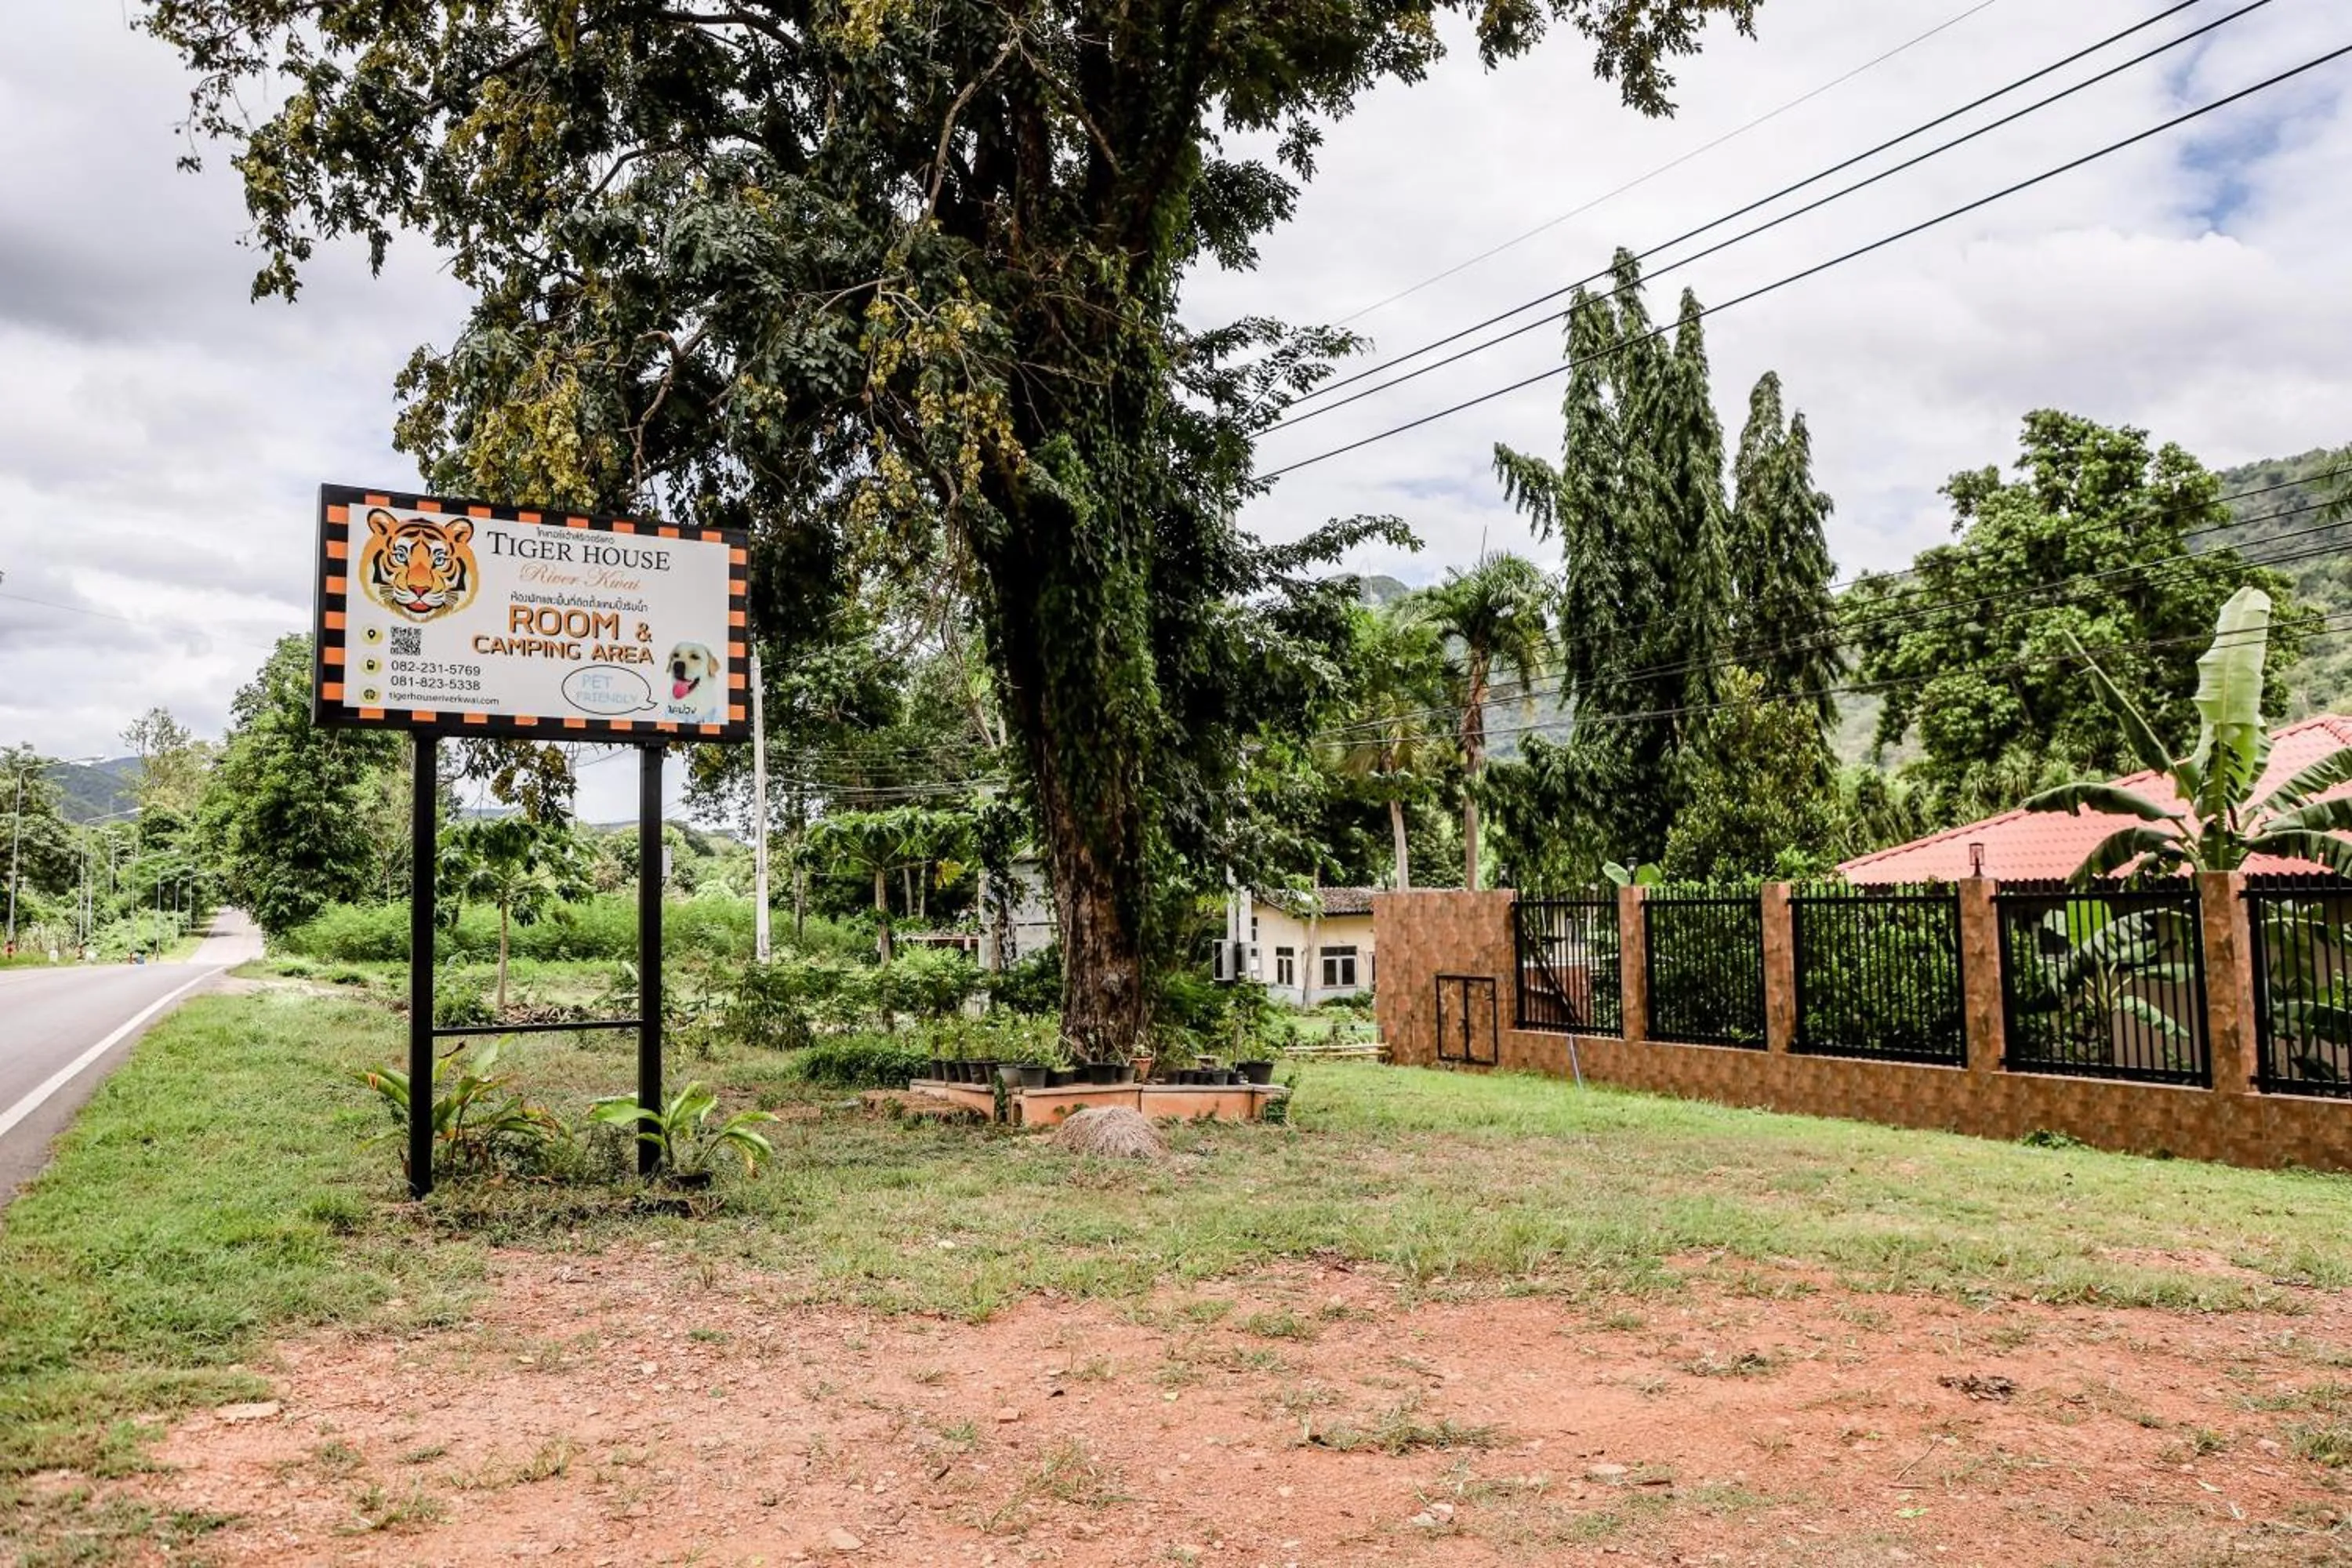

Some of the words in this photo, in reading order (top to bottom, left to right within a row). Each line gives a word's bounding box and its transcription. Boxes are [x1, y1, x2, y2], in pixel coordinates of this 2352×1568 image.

[487, 531, 574, 562] TIGER
[583, 544, 671, 572] HOUSE
[520, 561, 579, 585] River
[584, 565, 641, 590] Kwai
[510, 604, 619, 641] ROOM
[635, 622, 653, 644] &
[472, 634, 582, 661] CAMPING
[591, 644, 655, 666] AREA
[390, 659, 481, 677] 082-231-5769
[582, 673, 613, 689] PET
[390, 675, 481, 691] 081-823-5338
